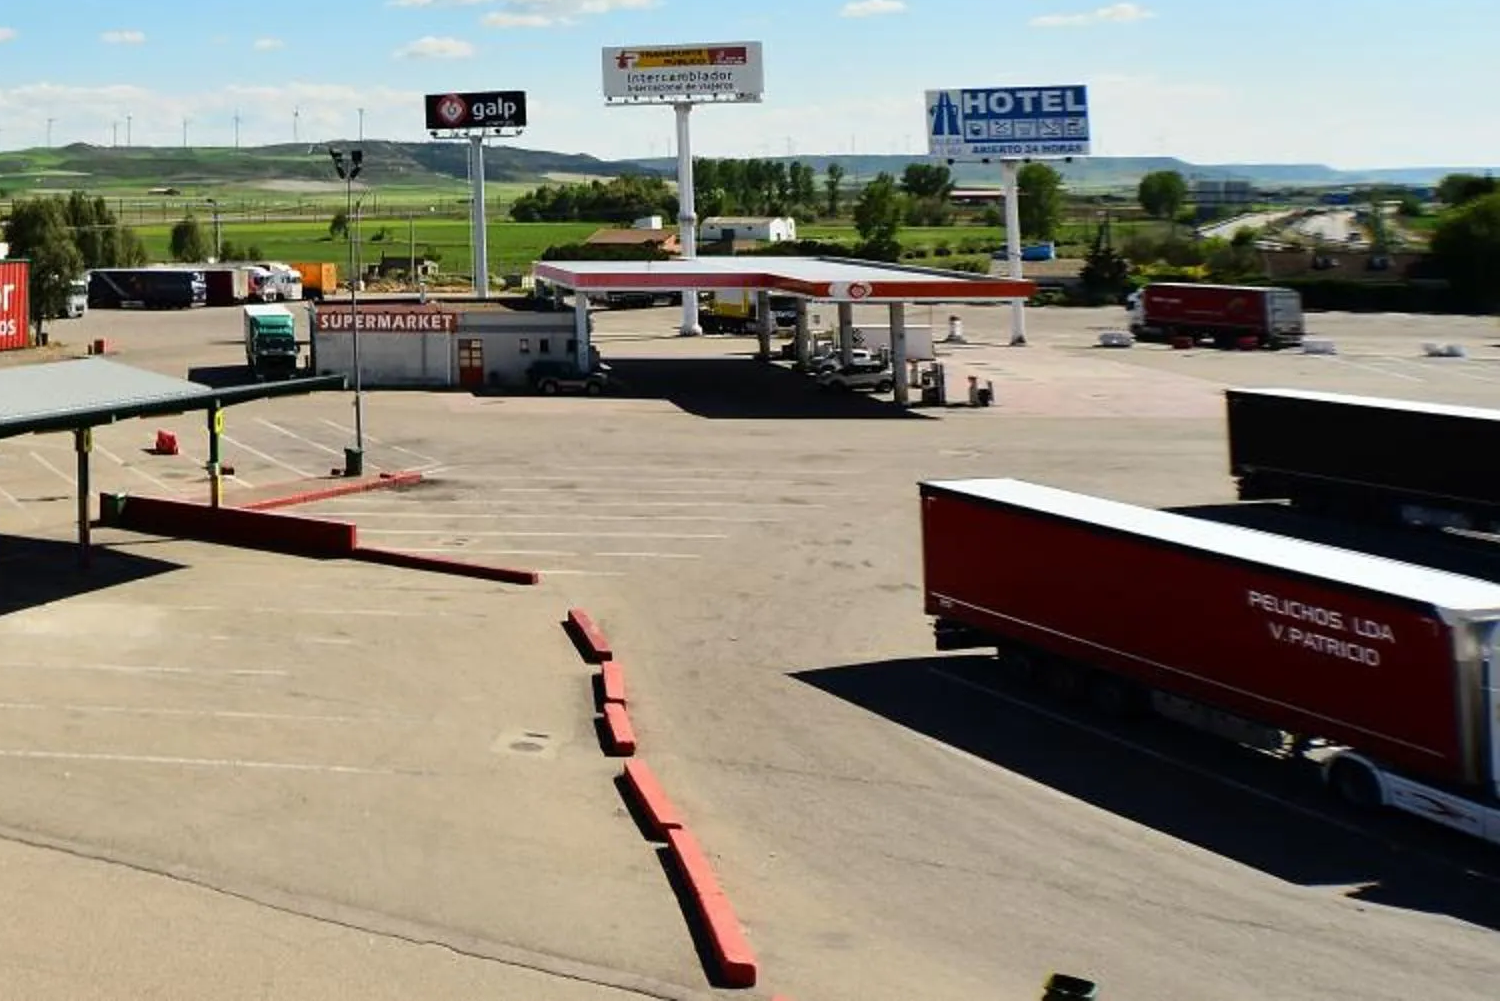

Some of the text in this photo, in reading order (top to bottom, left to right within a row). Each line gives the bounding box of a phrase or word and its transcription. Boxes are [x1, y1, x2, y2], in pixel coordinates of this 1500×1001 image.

[628, 70, 733, 83] Intercambiador
[472, 96, 517, 120] galp
[963, 90, 1085, 114] HOTEL
[320, 312, 453, 330] SUPERMARKET
[1354, 616, 1396, 644] LDA
